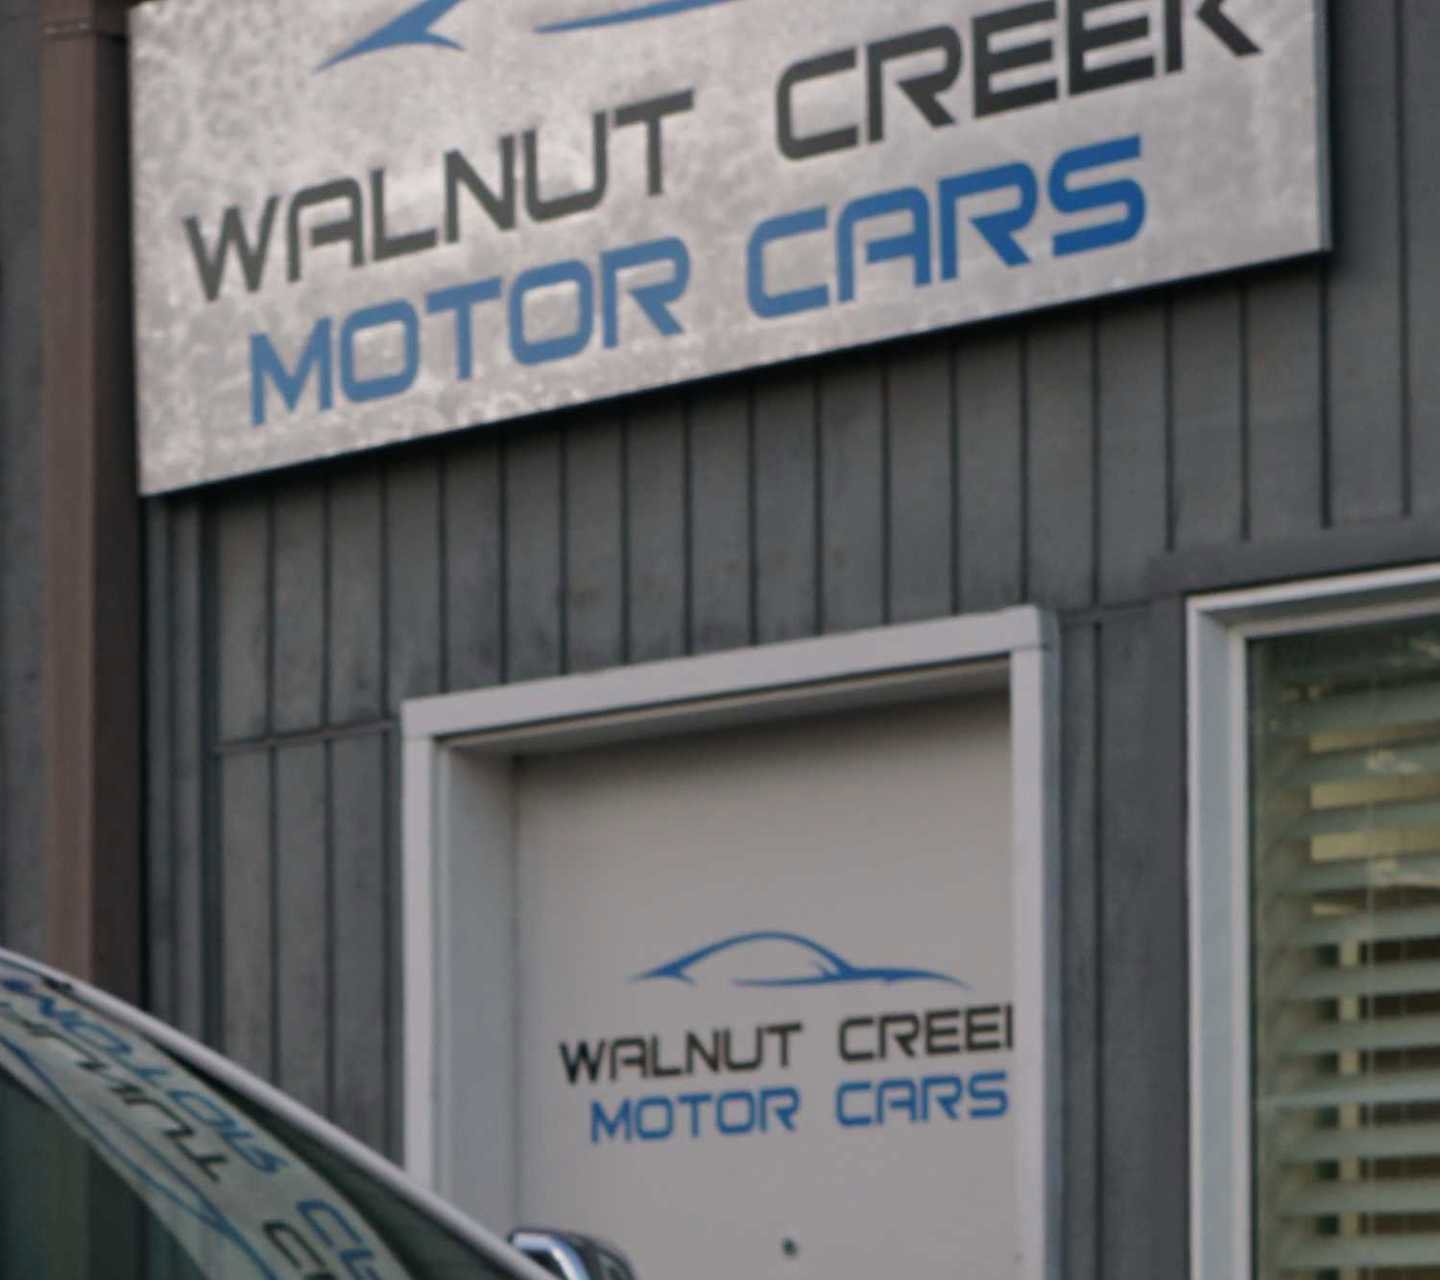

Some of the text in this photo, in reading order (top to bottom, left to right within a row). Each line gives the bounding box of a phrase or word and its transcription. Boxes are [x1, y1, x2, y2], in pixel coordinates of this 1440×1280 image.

[183, 0, 1263, 303] WALNUT CREEK
[249, 134, 1147, 426] MOTOR CARS
[559, 1022, 803, 1085] WALNUT
[590, 1071, 1009, 1144] MOTOR CARS
